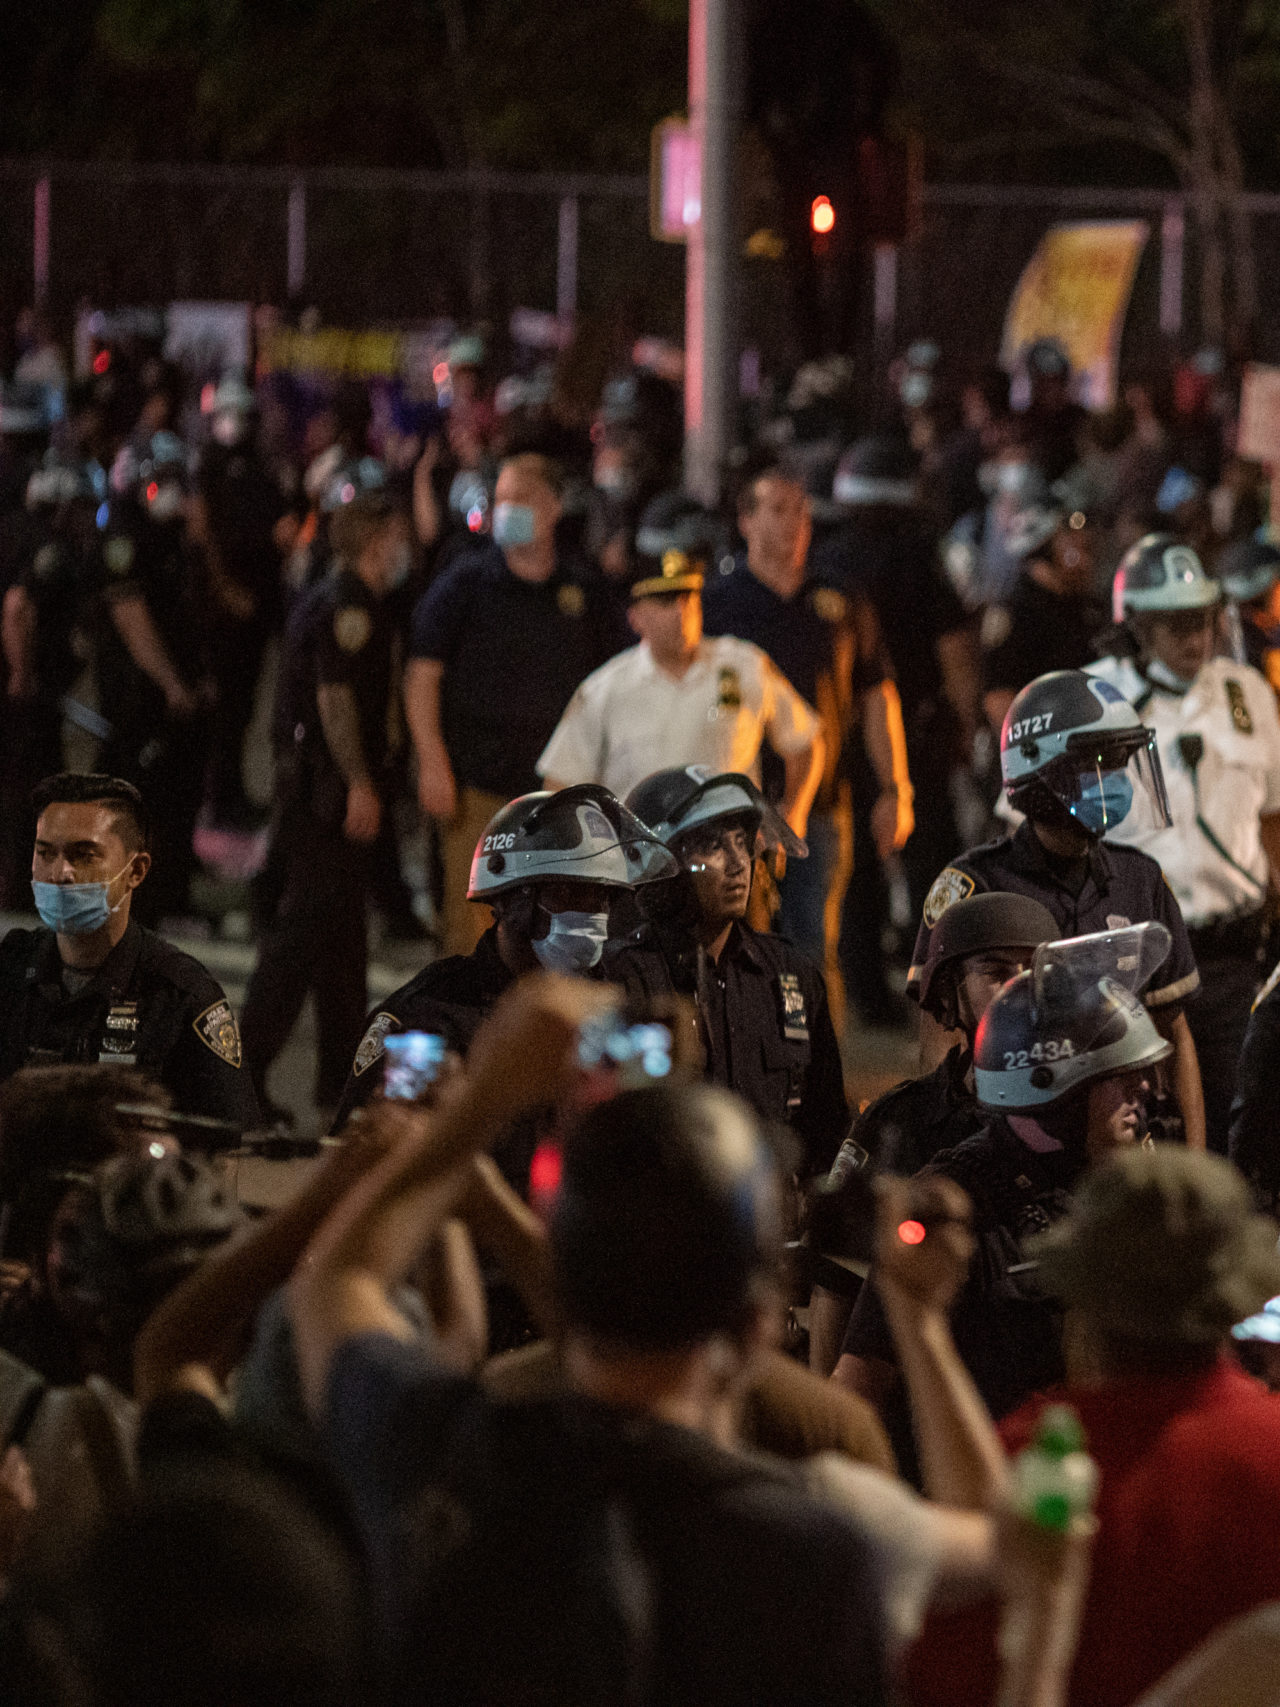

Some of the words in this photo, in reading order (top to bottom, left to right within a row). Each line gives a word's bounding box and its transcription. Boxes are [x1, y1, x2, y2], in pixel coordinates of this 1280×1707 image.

[1008, 712, 1053, 743] 13727
[483, 833, 516, 852] 2126
[1003, 1039, 1075, 1071] 22434
